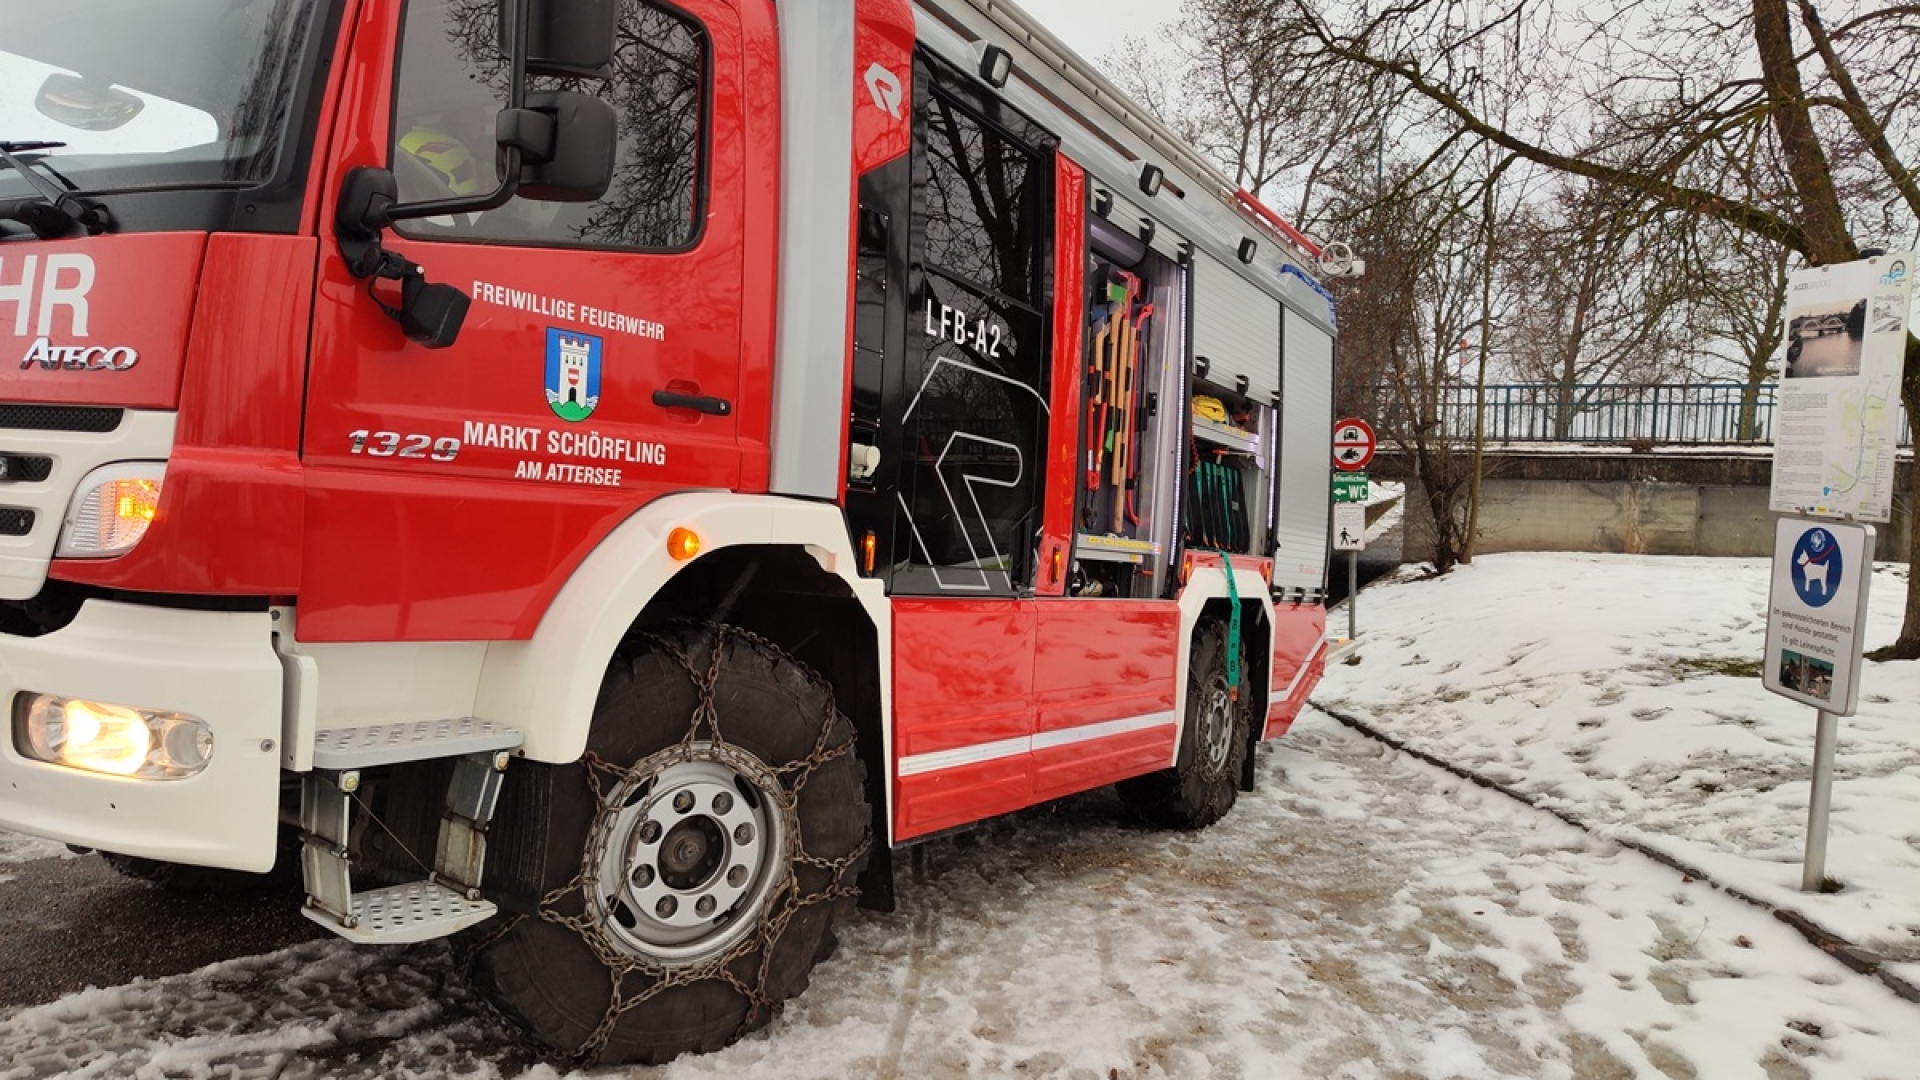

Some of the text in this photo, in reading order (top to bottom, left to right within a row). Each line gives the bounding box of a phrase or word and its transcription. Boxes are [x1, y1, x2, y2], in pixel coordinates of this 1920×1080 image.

[472, 280, 665, 341] FREIWILLIGE FEUERWEHR
[925, 298, 1001, 358] LFB-A2
[348, 428, 461, 462] 1329
[463, 420, 666, 465] MARKT SCHÖRFLING
[515, 460, 622, 487] AM ATTERSEE
[1348, 484, 1367, 499] WC
